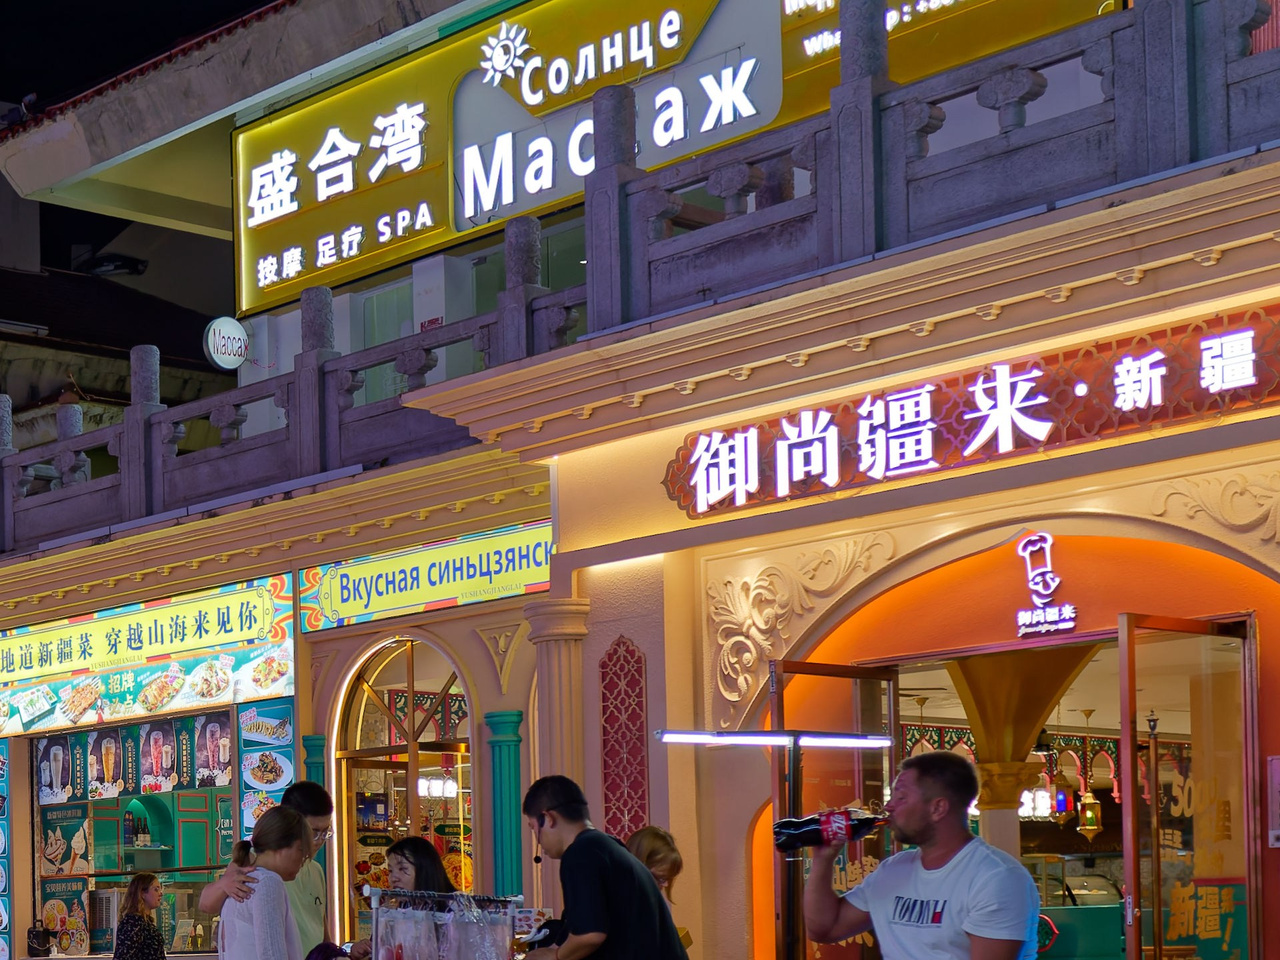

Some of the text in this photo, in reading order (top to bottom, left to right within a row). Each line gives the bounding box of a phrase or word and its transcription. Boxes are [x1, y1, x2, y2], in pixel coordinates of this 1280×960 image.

[519, 7, 682, 107] Солнце
[247, 101, 429, 230] 盛合湾
[463, 57, 760, 219] Масаж
[258, 202, 434, 288] 按摩 足疗 SPA
[340, 565, 420, 609] Вкусная
[0, 601, 258, 674] 地道新疆菜 穿越山海来见你
[108, 671, 135, 694] 招牌
